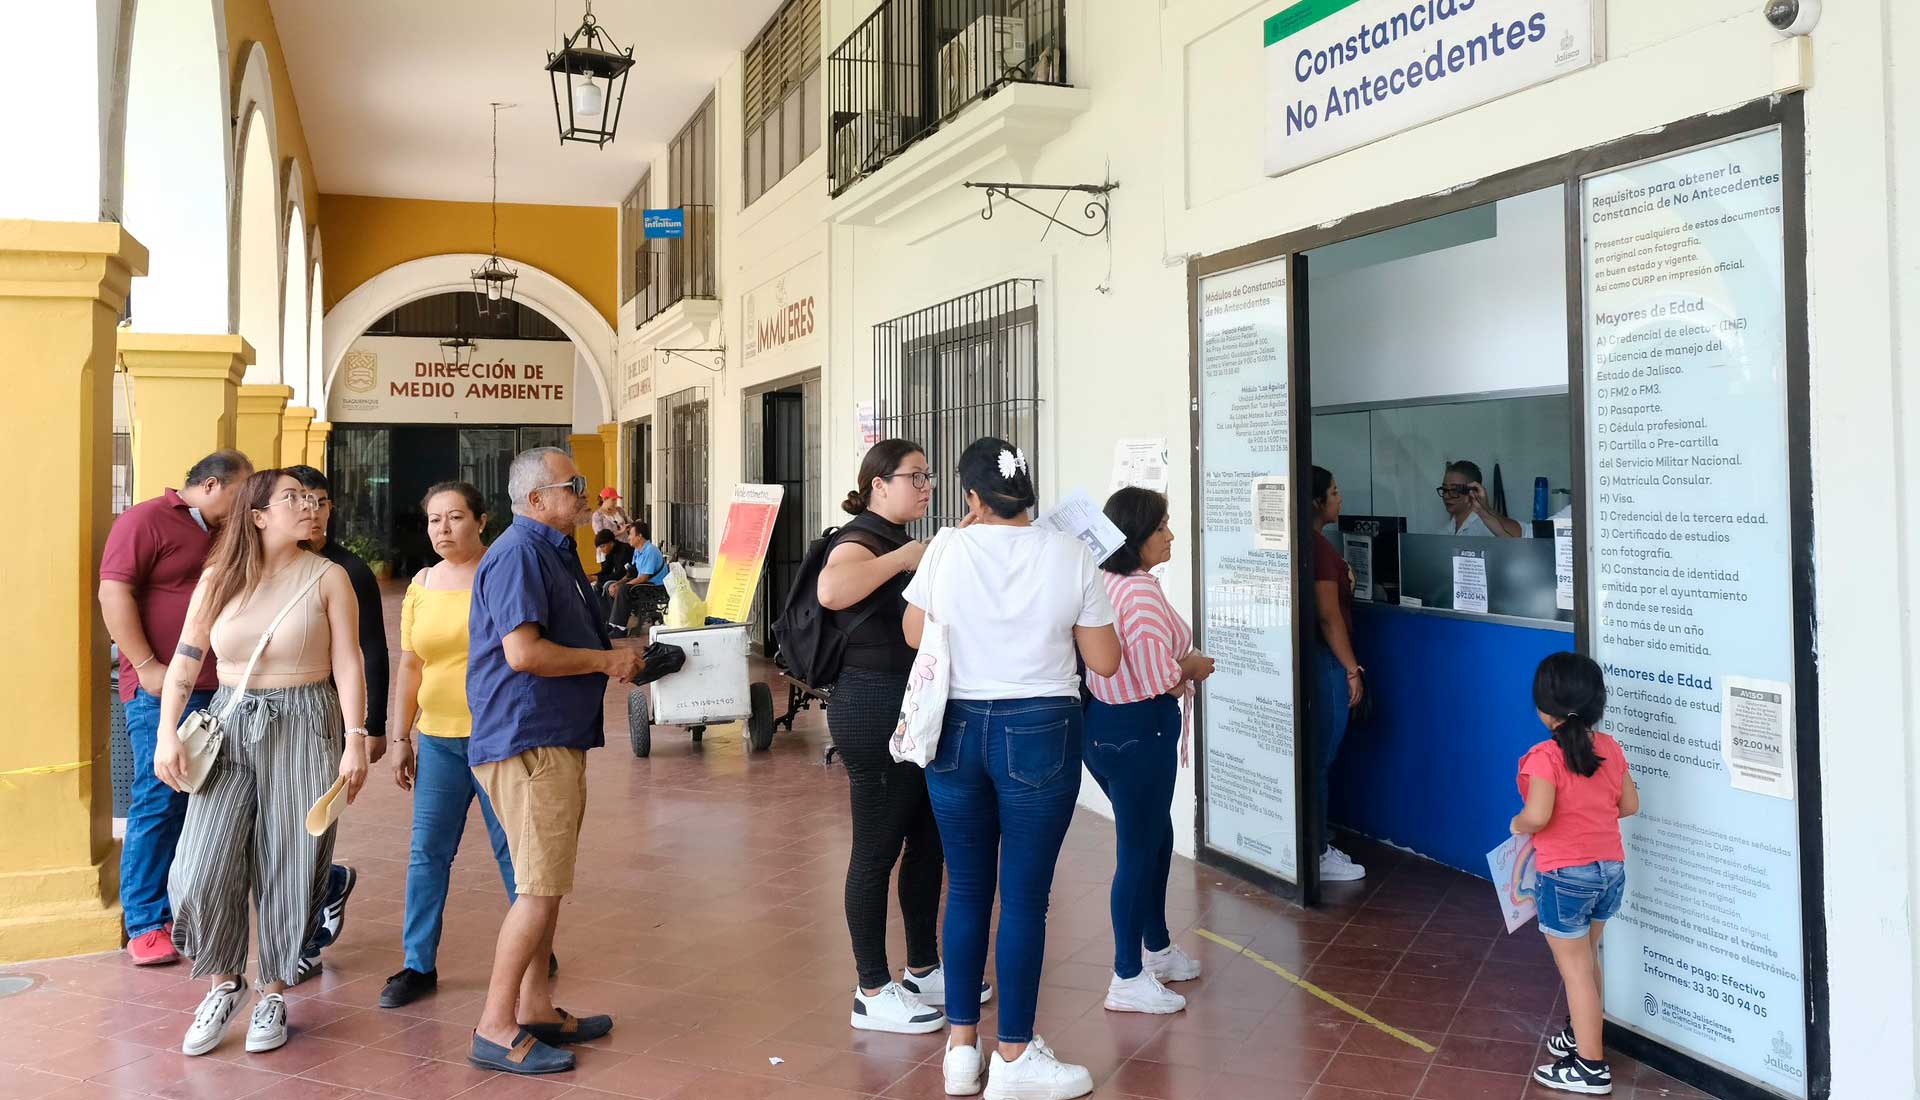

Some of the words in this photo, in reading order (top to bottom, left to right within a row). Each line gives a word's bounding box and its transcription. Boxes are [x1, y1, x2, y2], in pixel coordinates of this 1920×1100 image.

[1554, 50, 1580, 64] Jalisco
[1286, 100, 1318, 136] No
[1325, 10, 1547, 122] Antecedentes
[1592, 188, 1645, 208] Requisitos
[1648, 181, 1675, 197] para
[1678, 168, 1725, 187] obtener
[1728, 165, 1741, 175] la
[1592, 201, 1653, 223] Constancia
[1656, 197, 1670, 208] de
[1673, 193, 1688, 205] No
[1691, 173, 1779, 201] Antecedentes
[645, 220, 682, 228] infinitum
[1594, 236, 1633, 250] Presentar
[1635, 226, 1680, 241] cualquiera
[1682, 222, 1693, 232] de
[1694, 216, 1719, 229] estos
[1720, 203, 1780, 224] documentos
[1205, 289, 1232, 303] Módulos
[1232, 287, 1241, 296] de
[1241, 277, 1286, 294] Constancias
[1205, 307, 1213, 317] de
[1213, 305, 1222, 315] No
[1223, 297, 1270, 312] Antecedentes
[1595, 309, 1647, 326] Mayores
[1650, 305, 1666, 317] de
[1669, 299, 1704, 314] Edad
[1608, 349, 1648, 363] Licencia
[1650, 347, 1662, 358] de
[1665, 343, 1703, 356] manejo
[1705, 341, 1722, 351] del
[416, 359, 516, 379] DIRECCIÓN
[524, 364, 543, 379] DE
[1597, 368, 1630, 381] Estado
[1631, 367, 1644, 378] de
[1646, 365, 1683, 376] Jalisco.
[390, 382, 455, 398] MEDIO
[465, 383, 564, 400] AMBIENTE
[1597, 388, 1608, 399] C)
[1610, 386, 1629, 397] FM2
[1639, 384, 1661, 395] FM3.
[1597, 406, 1608, 416] D)
[1610, 404, 1662, 416] Pasaporte.
[1598, 423, 1607, 434] E)
[1609, 421, 1644, 432] Cédula
[1646, 418, 1707, 434] profesional.
[1598, 440, 1607, 451] F)
[1609, 439, 1646, 450] Cartilla
[1657, 437, 1719, 448] Pre-cartilla
[1599, 457, 1613, 468] del
[1615, 457, 1653, 468] Servicio
[1655, 456, 1688, 466] Militar
[1691, 455, 1742, 466] Nacional.
[1599, 475, 1610, 486] G)
[1661, 475, 1712, 485] Consular.
[1599, 493, 1610, 504] H)
[1612, 493, 1635, 503] Visa.
[1600, 510, 1607, 521] I)
[1609, 510, 1663, 522] Credencial
[1664, 512, 1678, 522] de
[1679, 512, 1690, 522] la
[1692, 513, 1733, 523] tercera
[1736, 513, 1768, 524] edad.
[1600, 528, 1610, 539] J)
[1611, 528, 1667, 540] Certificado
[1669, 530, 1682, 541] de
[1684, 531, 1730, 542] estudios
[1601, 548, 1618, 556] con
[1601, 563, 1611, 574] K)
[1613, 564, 1669, 577] Constancia
[1672, 567, 1685, 578] de
[1687, 568, 1739, 581] identidad
[1602, 581, 1637, 593] emitida
[1640, 586, 1657, 596] por
[1659, 585, 1668, 595] el
[1670, 588, 1747, 601] ayuntamiento
[1615, 599, 1646, 611] donde
[1647, 604, 1659, 613] se
[1661, 604, 1693, 616] resida
[1603, 616, 1614, 626] de
[1616, 619, 1628, 627] no
[1630, 619, 1651, 630] más
[1653, 621, 1666, 632] de
[1668, 625, 1681, 633] un
[1683, 624, 1704, 636] año
[1602, 633, 1615, 644] de
[1616, 634, 1644, 647] haber
[1647, 638, 1667, 650] sido
[1669, 642, 1711, 655] emitida.
[1602, 663, 1655, 681] Menores
[1658, 671, 1674, 684] de
[1677, 673, 1712, 690] Edad
[1616, 686, 1672, 705] Certificado
[1674, 696, 1687, 707] de
[1689, 701, 1722, 713] estudi
[1740, 690, 1764, 700] AVISO
[1603, 704, 1621, 714] con
[1616, 722, 1670, 742] Credencial
[1672, 733, 1685, 744] de
[1687, 738, 1721, 751] estudi
[1732, 736, 1763, 750] $92.00
[1764, 743, 1782, 754] M.N.
[1658, 748, 1671, 759] de
[1673, 754, 1722, 771] conducir.
[1639, 903, 1679, 924] momento
[1693, 924, 1728, 941] realizar
[1643, 945, 1674, 965] Forma
[1676, 958, 1688, 970] de
[1690, 965, 1719, 982] pago:
[1721, 973, 1765, 998] Efectivo
[1644, 962, 1690, 988] Informes:
[1692, 980, 1704, 993] 33
[1706, 986, 1719, 999] 30
[1721, 991, 1735, 1005] 30
[1737, 997, 1750, 1011] 94
[1753, 1004, 1767, 1017] 05
[1661, 999, 1691, 1017] Instituto
[1692, 1011, 1732, 1033] Jalisciense
[1661, 1007, 1670, 1016] de
[1671, 1011, 1701, 1029] Ciencias
[1702, 1023, 1735, 1043] Forenses
[1763, 1054, 1802, 1078] Jalisco
